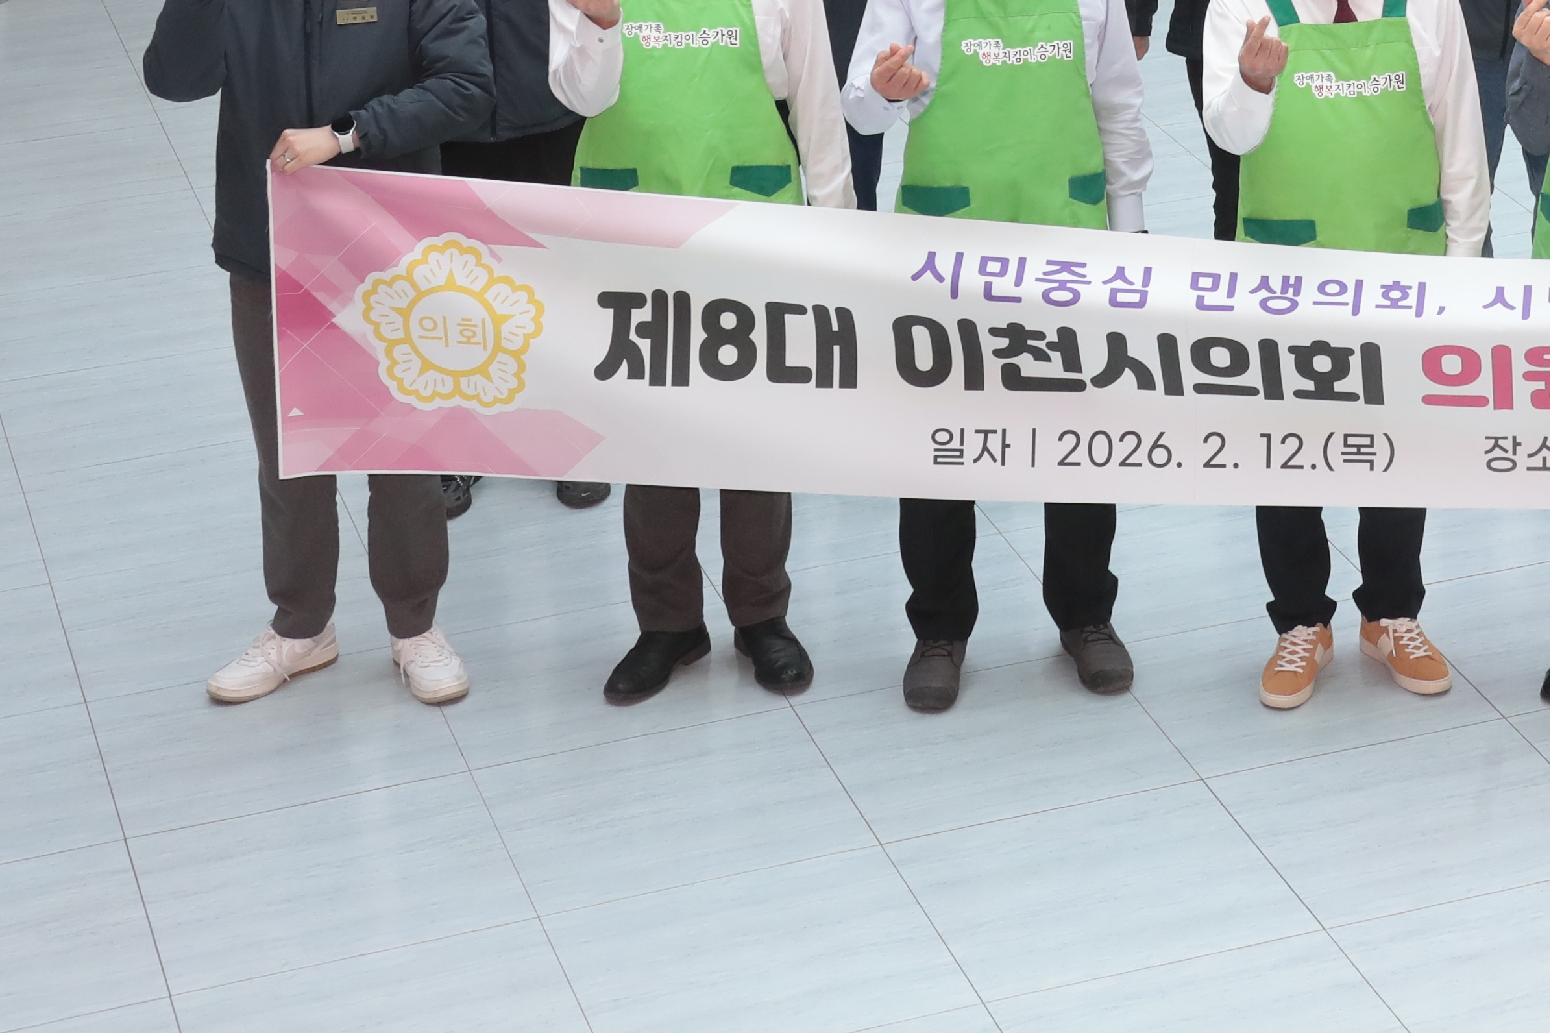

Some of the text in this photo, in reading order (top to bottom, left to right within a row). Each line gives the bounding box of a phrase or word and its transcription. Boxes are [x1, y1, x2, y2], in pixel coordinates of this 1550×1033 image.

[624, 23, 663, 36] 장애가족
[698, 29, 739, 47] 승가원
[962, 40, 1002, 53] 장애가족
[1036, 41, 1073, 61] 승가원
[1294, 73, 1334, 87] 장애가족
[1370, 73, 1406, 93] 승가원
[910, 251, 1152, 309] 시민중심
[1190, 271, 1446, 318] 민생의회,
[418, 316, 488, 351] 의회
[593, 289, 858, 389] 제8대
[892, 315, 1386, 405] 이천시의회
[930, 427, 1012, 467] 일자
[1056, 428, 1183, 470] 2026.
[1202, 431, 1239, 470] 2.
[1259, 431, 1396, 474] 12.(목)
